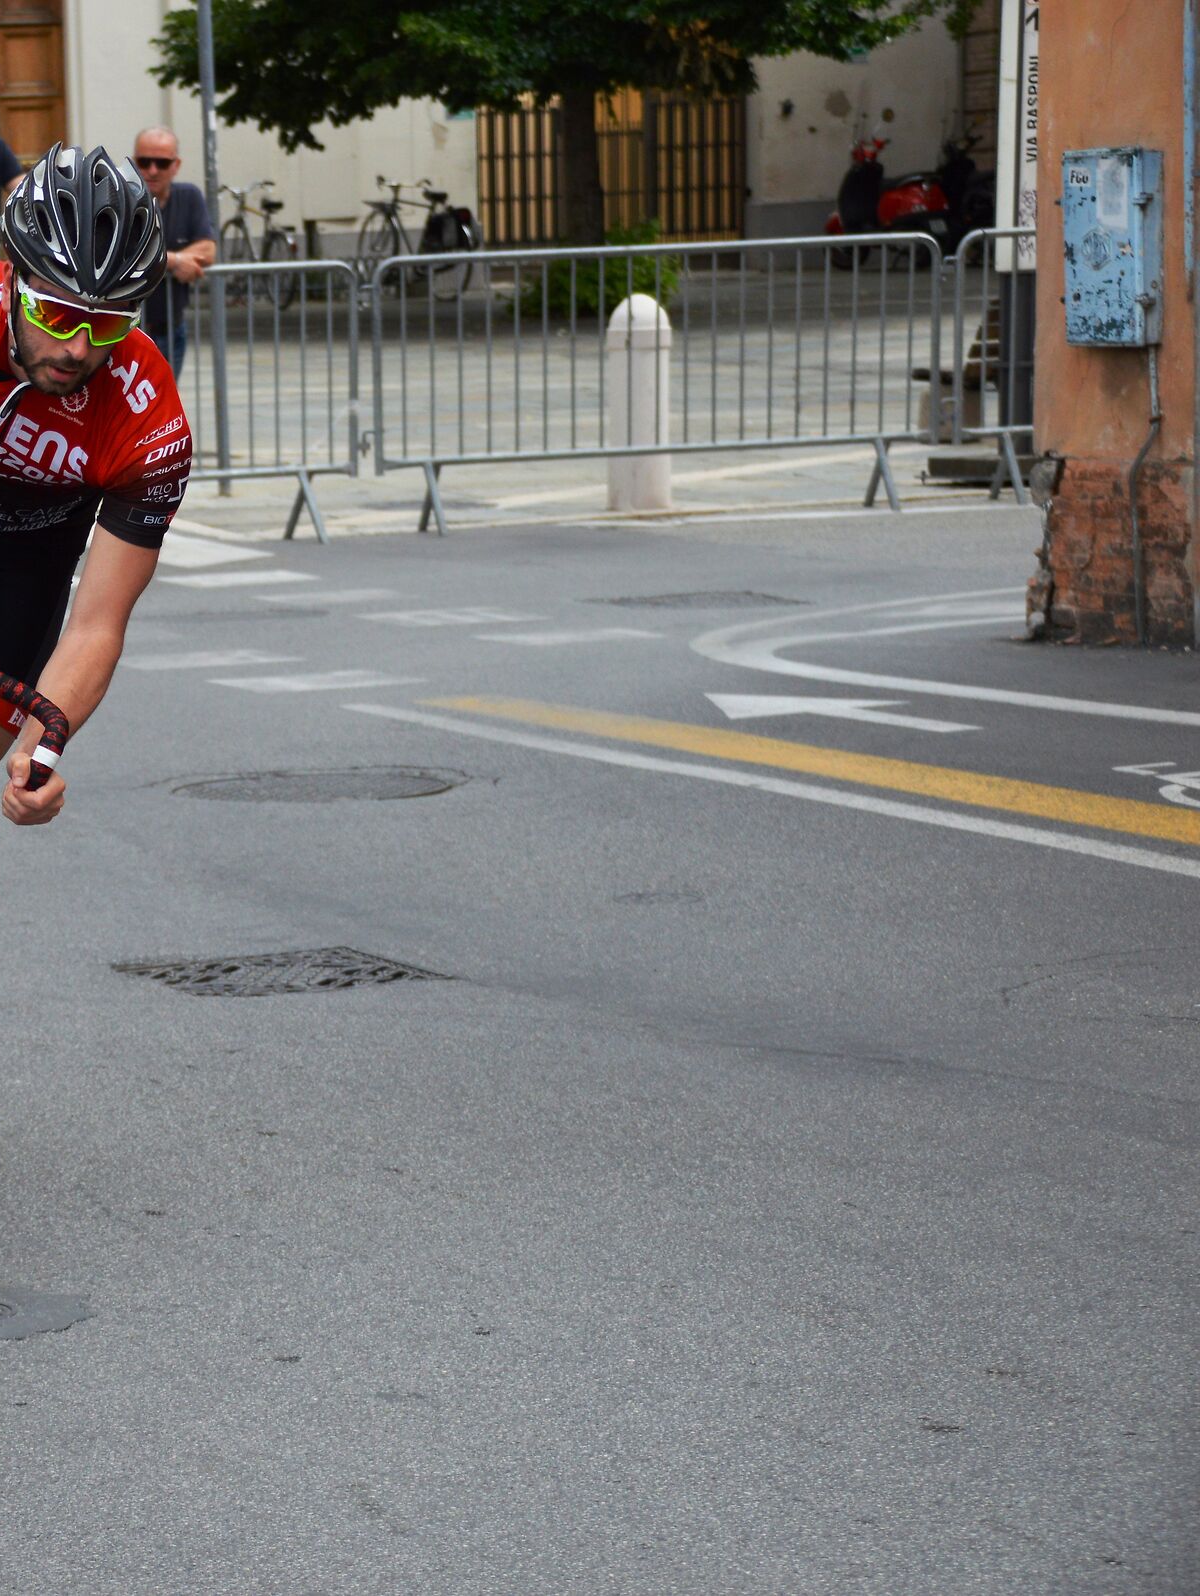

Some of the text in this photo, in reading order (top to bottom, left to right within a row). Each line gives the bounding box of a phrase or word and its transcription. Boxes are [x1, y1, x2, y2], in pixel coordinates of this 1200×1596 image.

[1026, 137, 1038, 163] VIA
[144, 435, 190, 465] DMT
[147, 483, 173, 496] VELO
